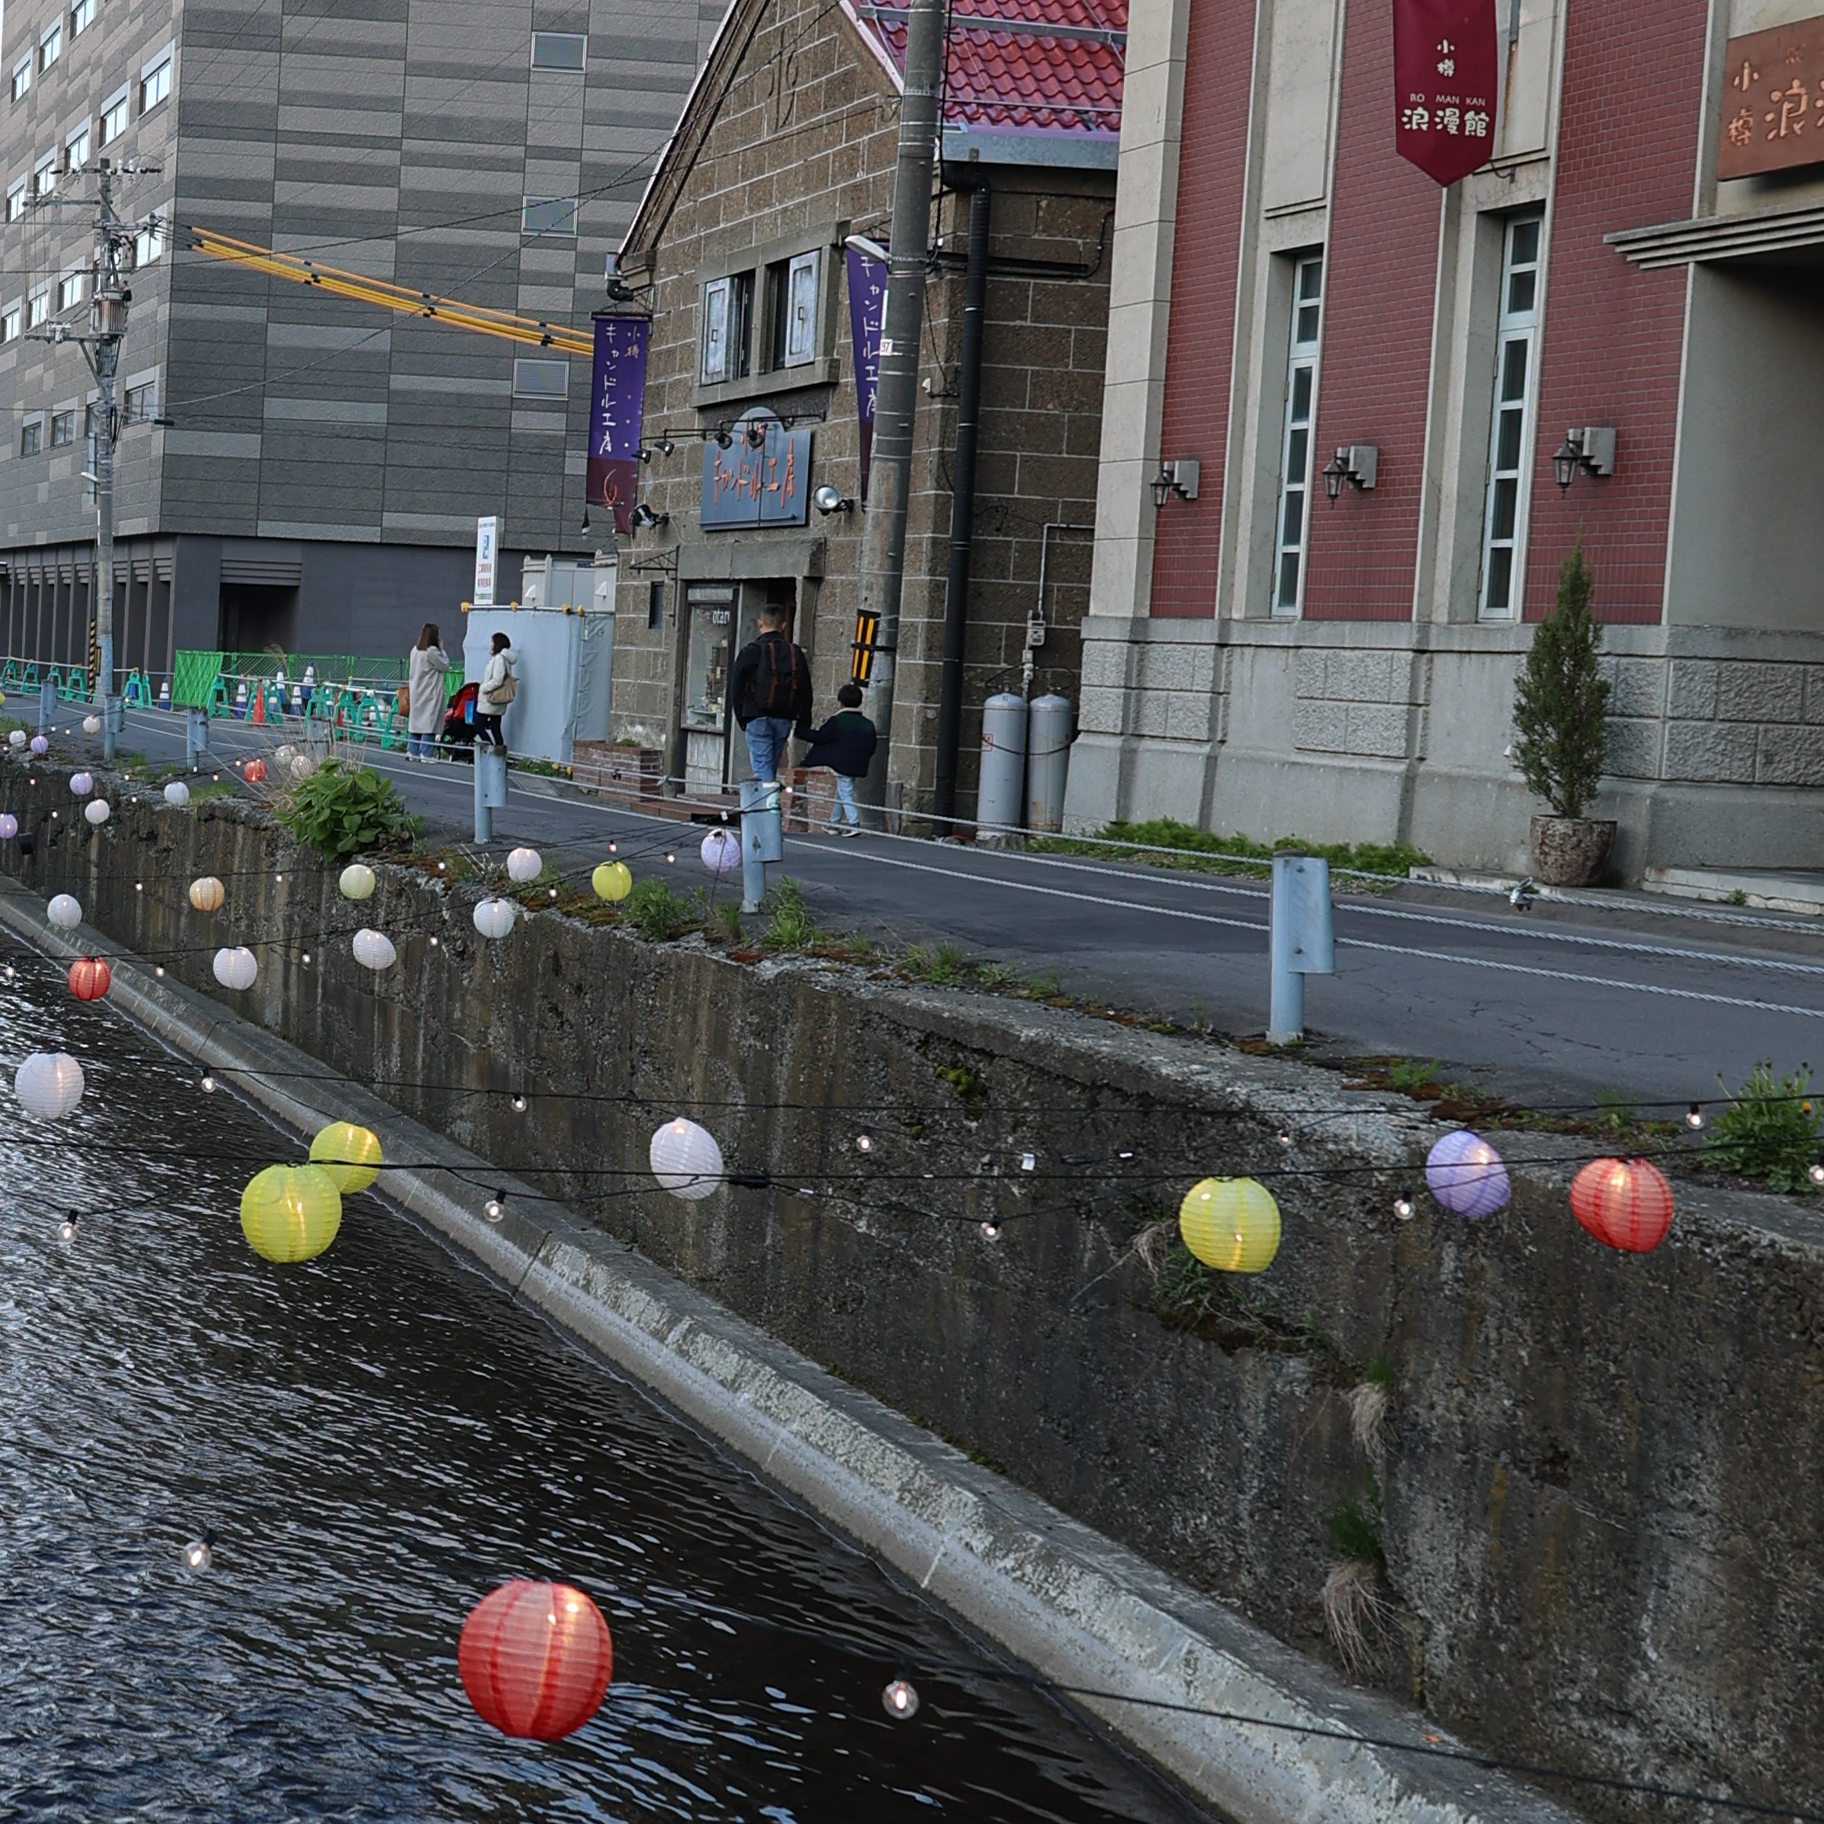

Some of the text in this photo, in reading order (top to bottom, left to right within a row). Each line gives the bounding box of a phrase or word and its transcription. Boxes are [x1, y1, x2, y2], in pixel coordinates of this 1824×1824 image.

[1437, 39, 1455, 77] 小樽
[1435, 94, 1460, 104] MAN
[1466, 97, 1486, 107] KAN
[1401, 106, 1490, 137] 浪漫館
